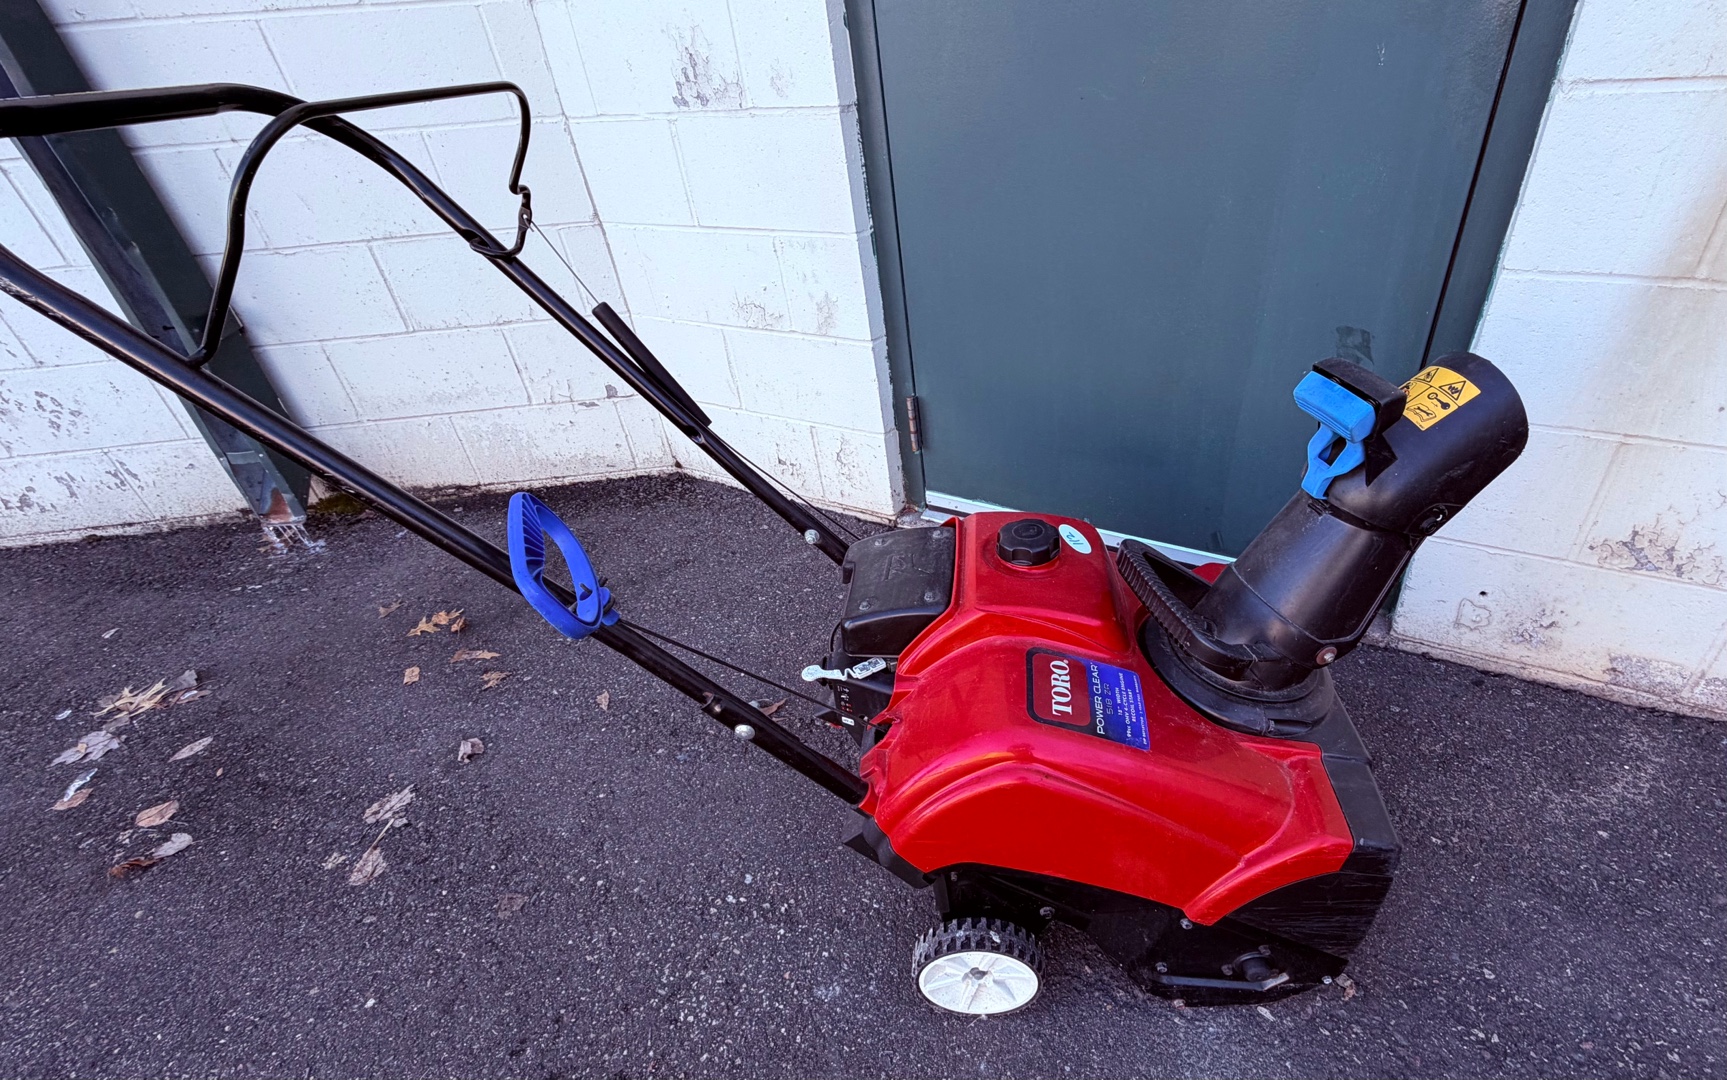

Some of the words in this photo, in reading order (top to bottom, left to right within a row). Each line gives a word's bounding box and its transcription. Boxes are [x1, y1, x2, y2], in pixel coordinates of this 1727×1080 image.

[1050, 660, 1072, 716] TORO
[1091, 665, 1101, 694] CLEAR
[1104, 683, 1111, 695] ZR
[1095, 696, 1105, 735] POWER
